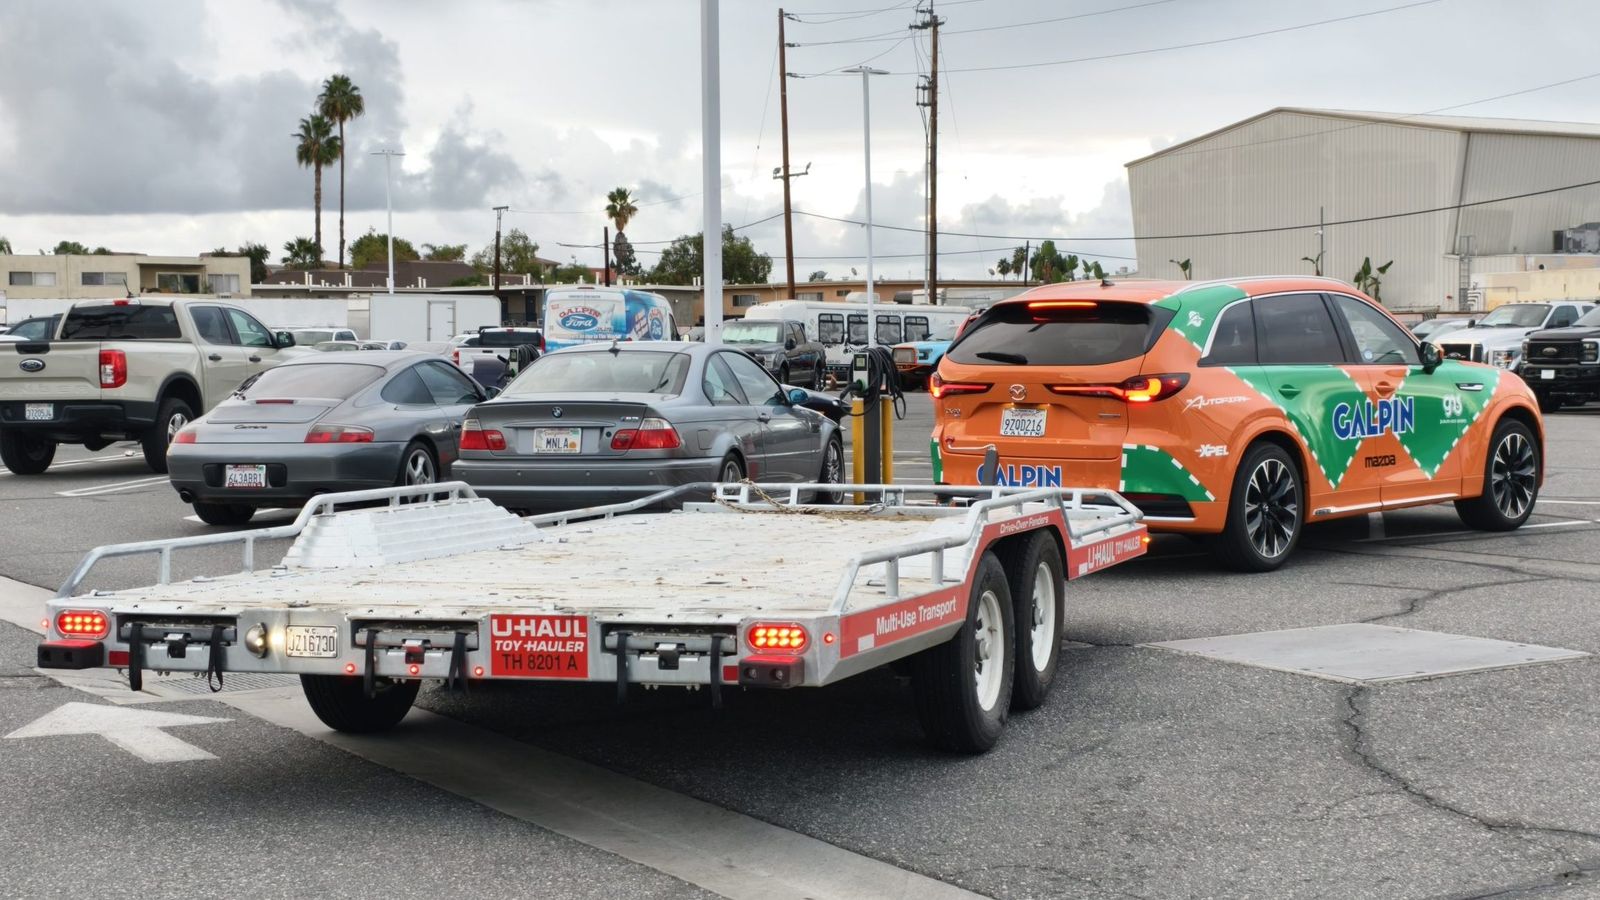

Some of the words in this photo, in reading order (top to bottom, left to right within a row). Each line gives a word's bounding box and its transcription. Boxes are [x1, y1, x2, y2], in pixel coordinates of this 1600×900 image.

[1332, 396, 1415, 440] GALPIN
[546, 437, 569, 449] MNLA
[1198, 444, 1229, 457] XPEL
[1028, 515, 1049, 528] Fenders
[1088, 541, 1115, 568] U-HAUL
[876, 609, 917, 636] Multi-Use
[918, 596, 957, 622] Transport
[491, 619, 587, 638] U-HAUL
[502, 653, 522, 670] TH
[527, 654, 560, 671] 8201
[566, 655, 578, 671] A
